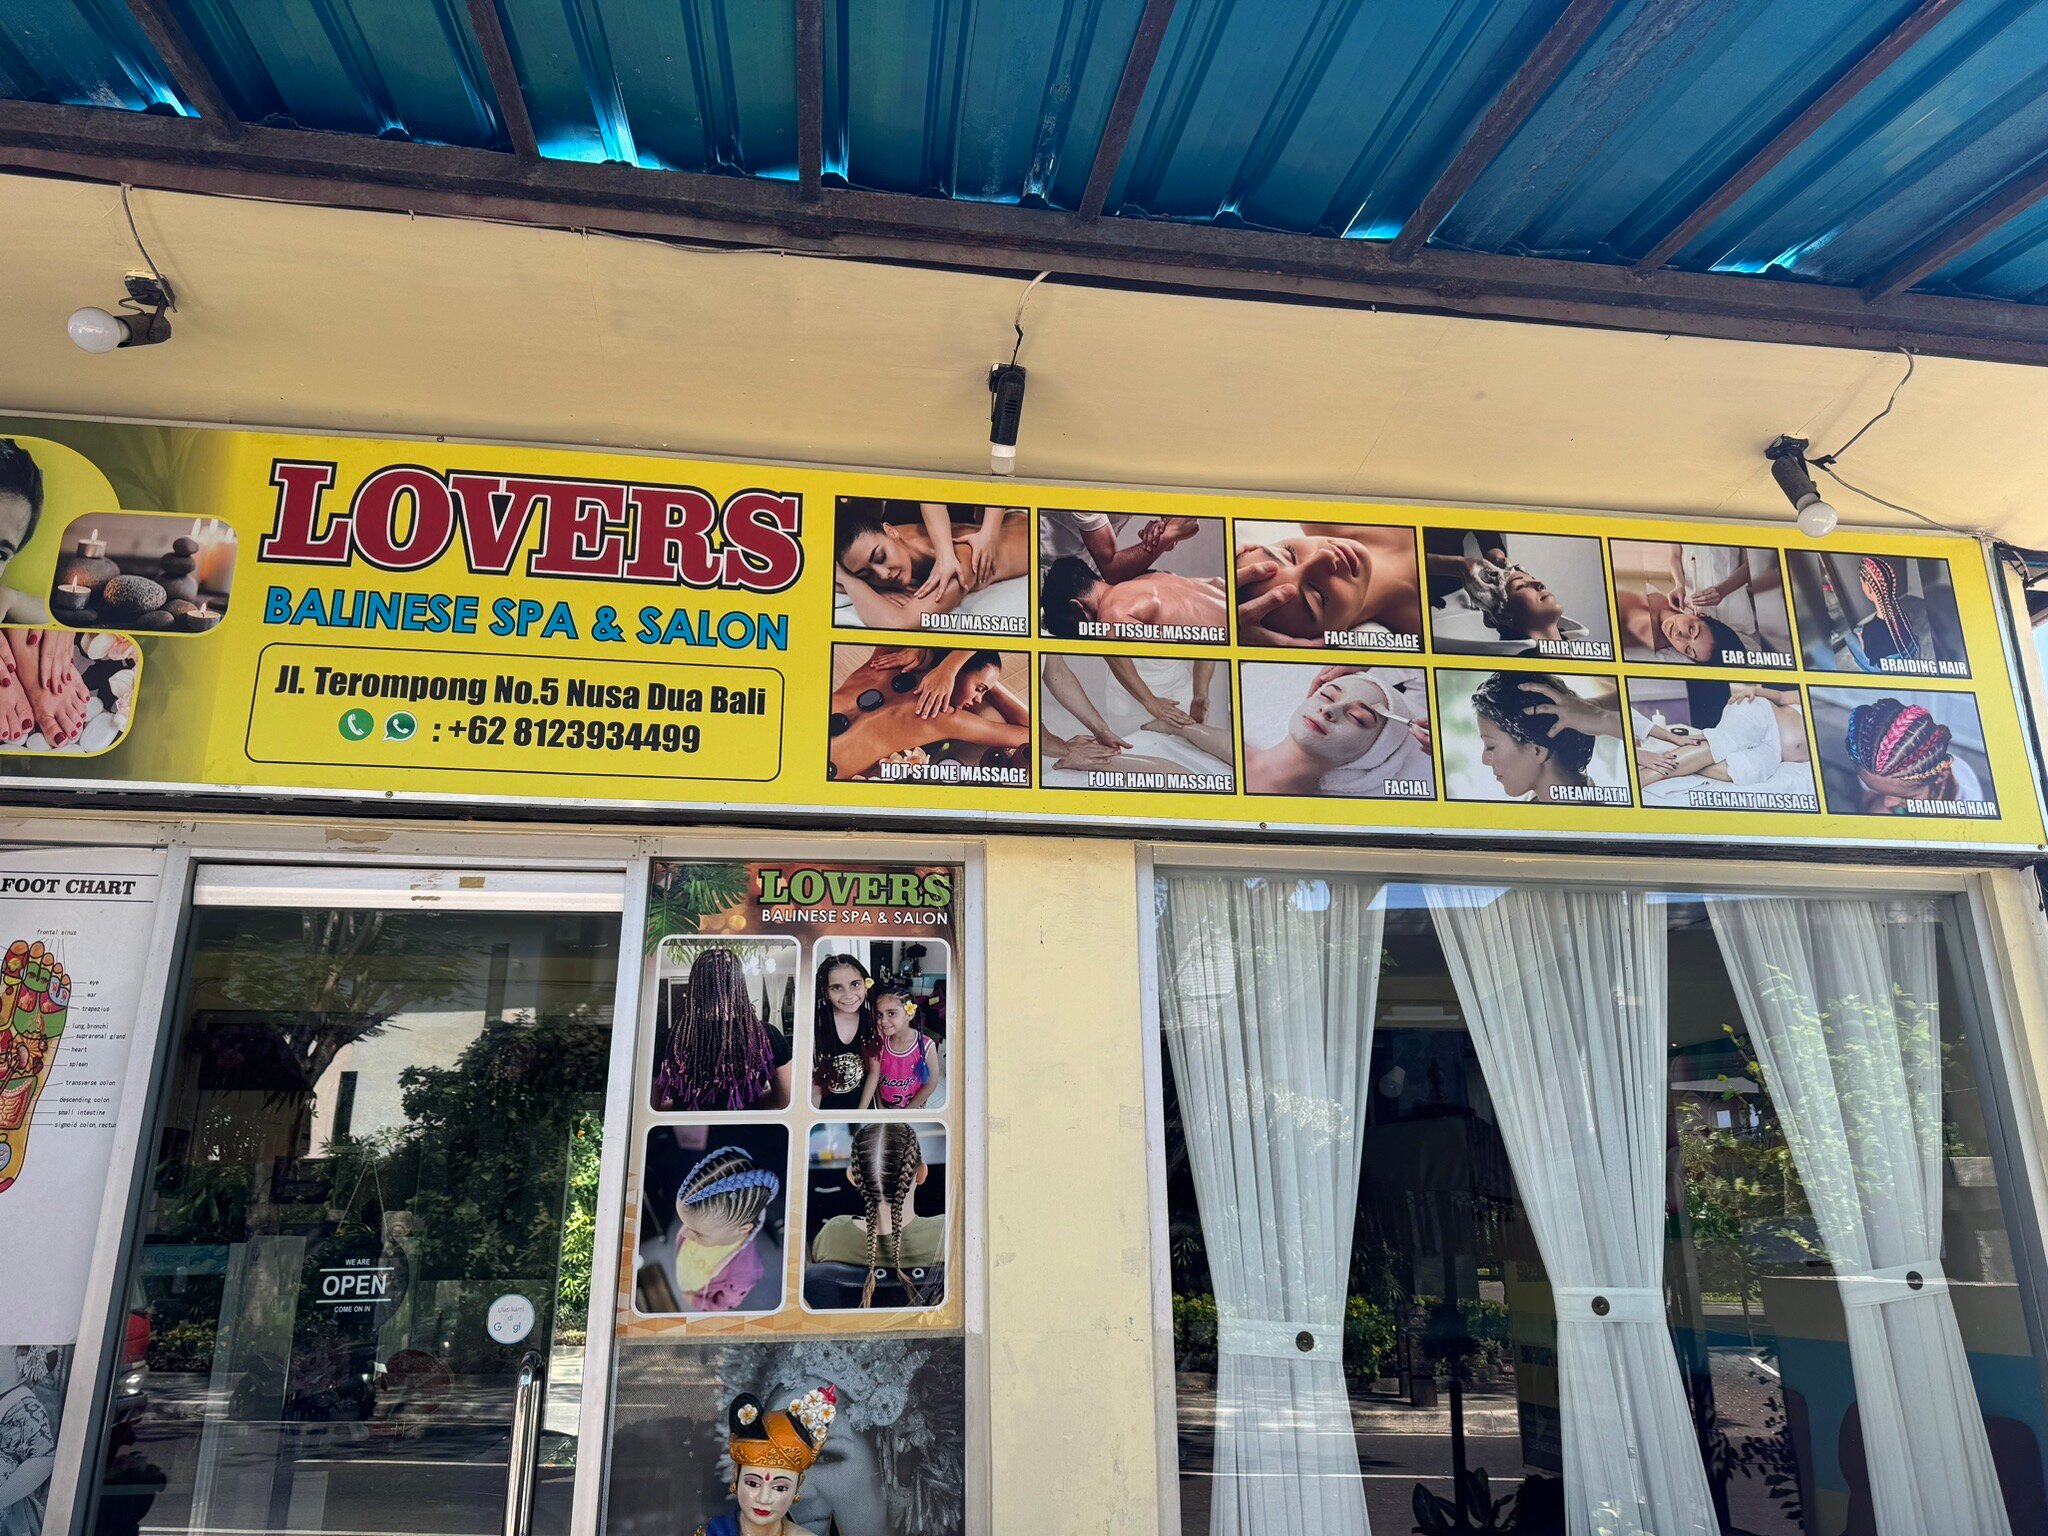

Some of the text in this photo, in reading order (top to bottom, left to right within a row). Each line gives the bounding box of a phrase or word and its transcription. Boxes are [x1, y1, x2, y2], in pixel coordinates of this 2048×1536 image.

[257, 458, 804, 594] LOVERS
[263, 586, 789, 651] BALINESE SPA & SALON
[921, 612, 1027, 633] BODY MASSAGE
[1078, 621, 1226, 642] DEEP TISSUE MASSAGE
[1323, 630, 1420, 649] FACE MASSAGE
[1539, 640, 1611, 657] HAIR WASH
[1722, 650, 1794, 667] EAR CANDLE
[1880, 658, 1968, 676] BRAIDING HAIR
[314, 666, 488, 706] Terompong
[493, 675, 559, 706] No.5
[566, 678, 640, 710] Nusa
[647, 682, 703, 713] Dua
[710, 685, 767, 715] Bali
[447, 714, 508, 746] +62
[512, 716, 701, 754] 8123934499
[881, 763, 1027, 783] HOT STONE MASSAGE
[1088, 772, 1233, 791] FOUR HAND MASSAGE
[1384, 779, 1431, 797] FACIAL
[1549, 785, 1629, 803] CREAMBATH
[1689, 790, 1817, 810] PREGNANT MASSAGE
[1907, 799, 1998, 817] BRAIDING HAIR
[0, 878, 137, 895] FOOT CHART
[758, 869, 952, 908] LOVERS
[761, 909, 949, 925] BALINESE SPA & SALON
[82, 1005, 110, 1013] trapezius
[76, 1032, 107, 1040] suprarenal
[69, 1061, 89, 1069] spleen
[345, 1258, 371, 1266] WE ARE
[322, 1273, 387, 1297] OPEN
[353, 1305, 364, 1313] ON
[364, 1305, 371, 1313] IN
